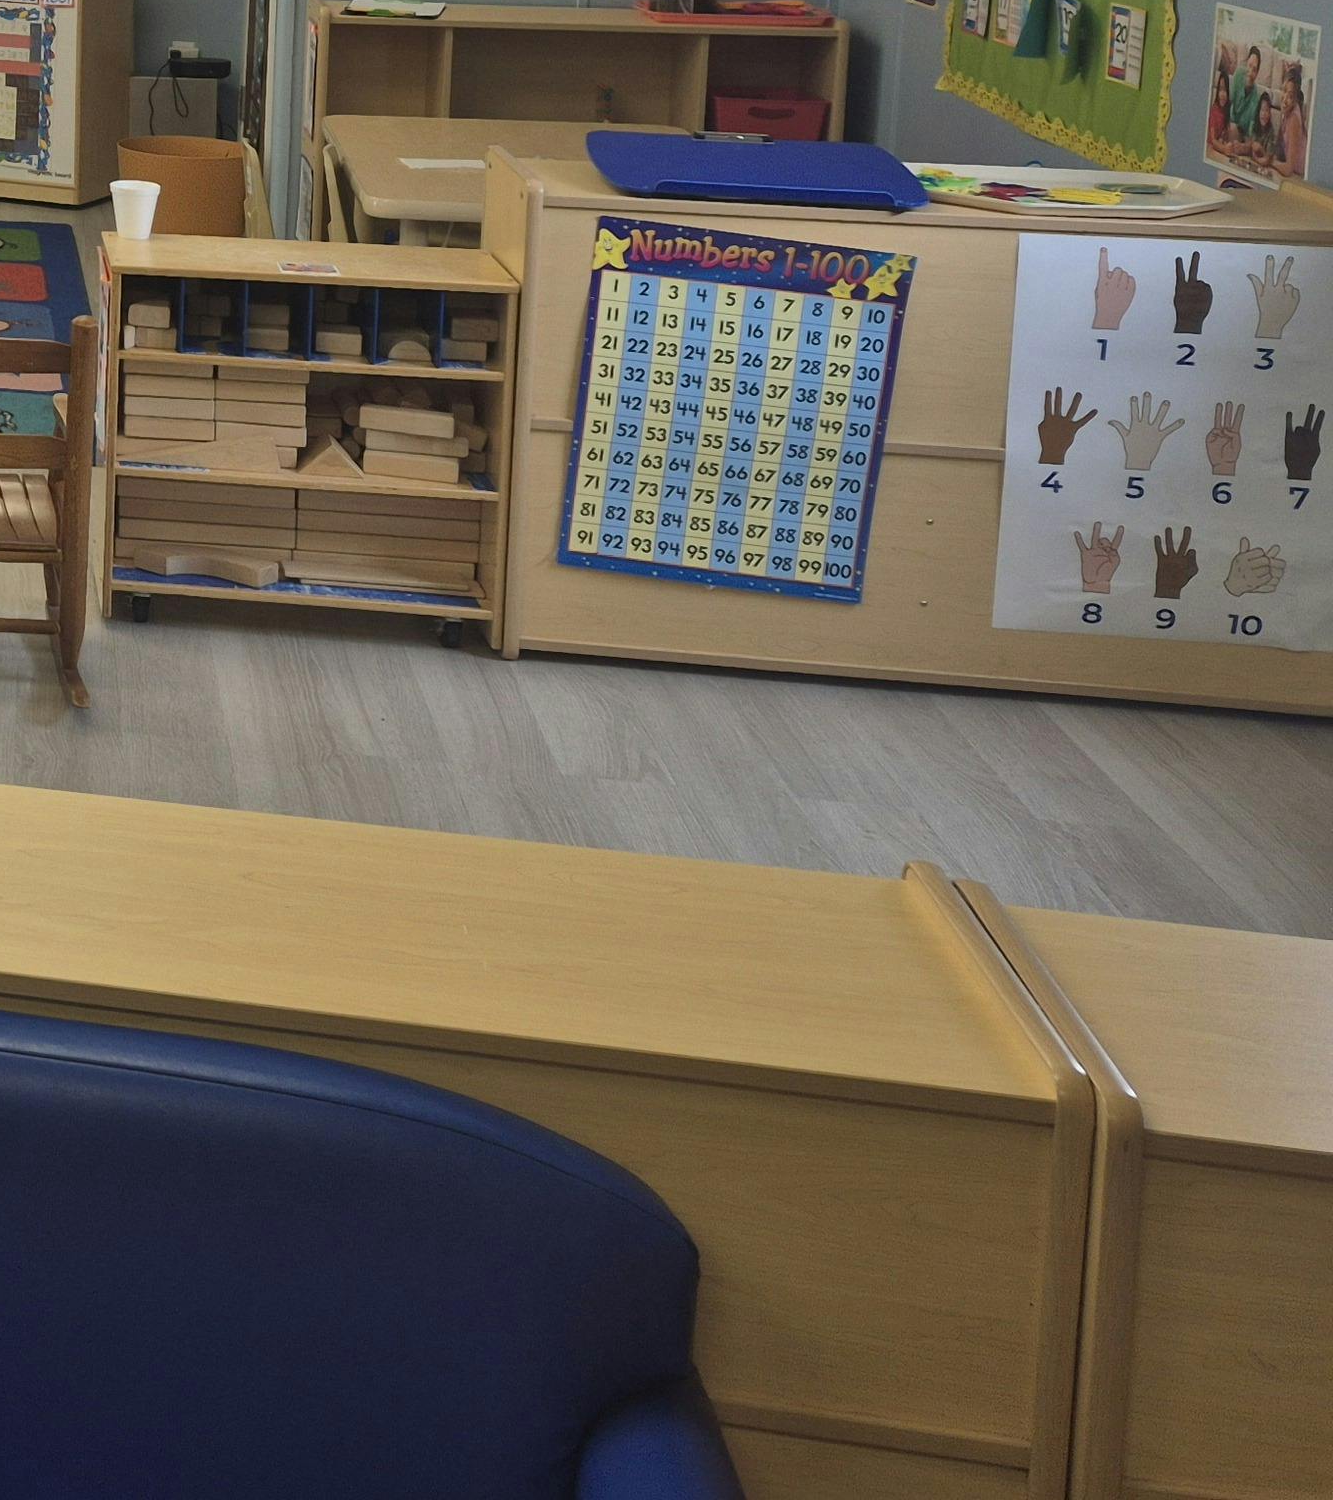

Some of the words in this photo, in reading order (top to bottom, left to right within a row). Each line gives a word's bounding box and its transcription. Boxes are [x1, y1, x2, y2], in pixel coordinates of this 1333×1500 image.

[1115, 22, 1128, 44] 20
[629, 228, 776, 273] Numbers
[784, 247, 873, 286] 1-100
[614, 279, 619, 293] 1
[639, 282, 650, 296] 2
[668, 285, 679, 300] 3
[697, 289, 707, 302] 4
[725, 291, 737, 307] 5
[753, 295, 765, 310] 6
[783, 298, 795, 313] 7
[812, 302, 823, 317] 8
[841, 305, 854, 320] 9
[868, 309, 886, 324] 10
[1096, 339, 1109, 361] 1
[1175, 343, 1196, 366] 2
[1253, 348, 1274, 371] 3
[595, 392, 612, 407] 41
[621, 395, 642, 411] 42
[649, 398, 671, 415] 43
[676, 402, 699, 418] 44
[705, 405, 728, 422] 45
[733, 409, 756, 425] 46
[762, 412, 786, 428] 47
[791, 416, 814, 432] 48
[819, 419, 843, 435] 49
[847, 422, 871, 438] 50
[1040, 471, 1063, 494] 4
[1125, 476, 1145, 500] 5
[1211, 481, 1233, 505] 6
[1288, 487, 1311, 510] 7
[577, 530, 593, 545] 91
[602, 533, 624, 550] 92
[630, 536, 652, 554] 93
[657, 540, 680, 557] 94
[686, 544, 708, 561] 95
[714, 548, 736, 565] 96
[743, 552, 765, 568] 97
[771, 555, 793, 572] 98
[798, 559, 822, 575] 99
[822, 561, 853, 579] 100
[1081, 603, 1103, 624] 8
[1155, 608, 1177, 629] 9
[1227, 614, 1263, 636] 10
